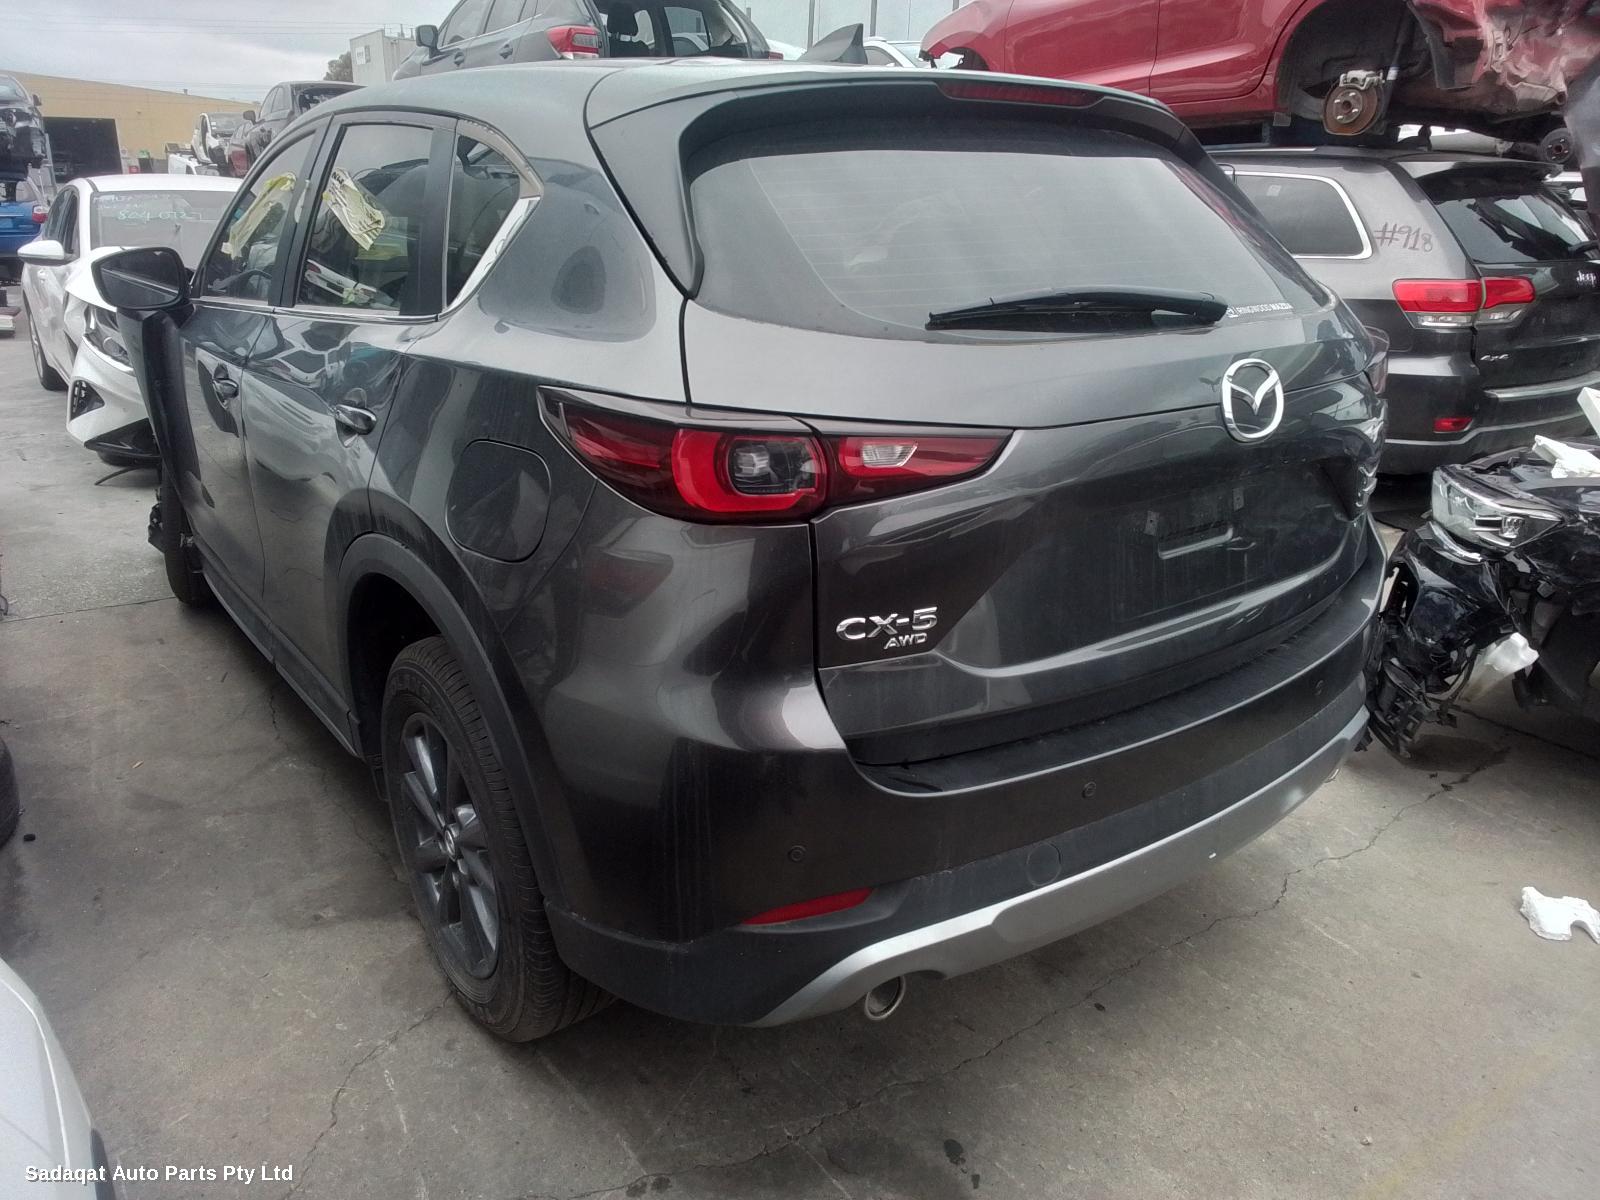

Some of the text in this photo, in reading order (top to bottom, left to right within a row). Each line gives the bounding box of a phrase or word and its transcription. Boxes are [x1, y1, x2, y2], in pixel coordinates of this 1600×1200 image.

[1374, 222, 1433, 253] #918
[836, 606, 938, 641] CX-5
[883, 633, 928, 650] AWD
